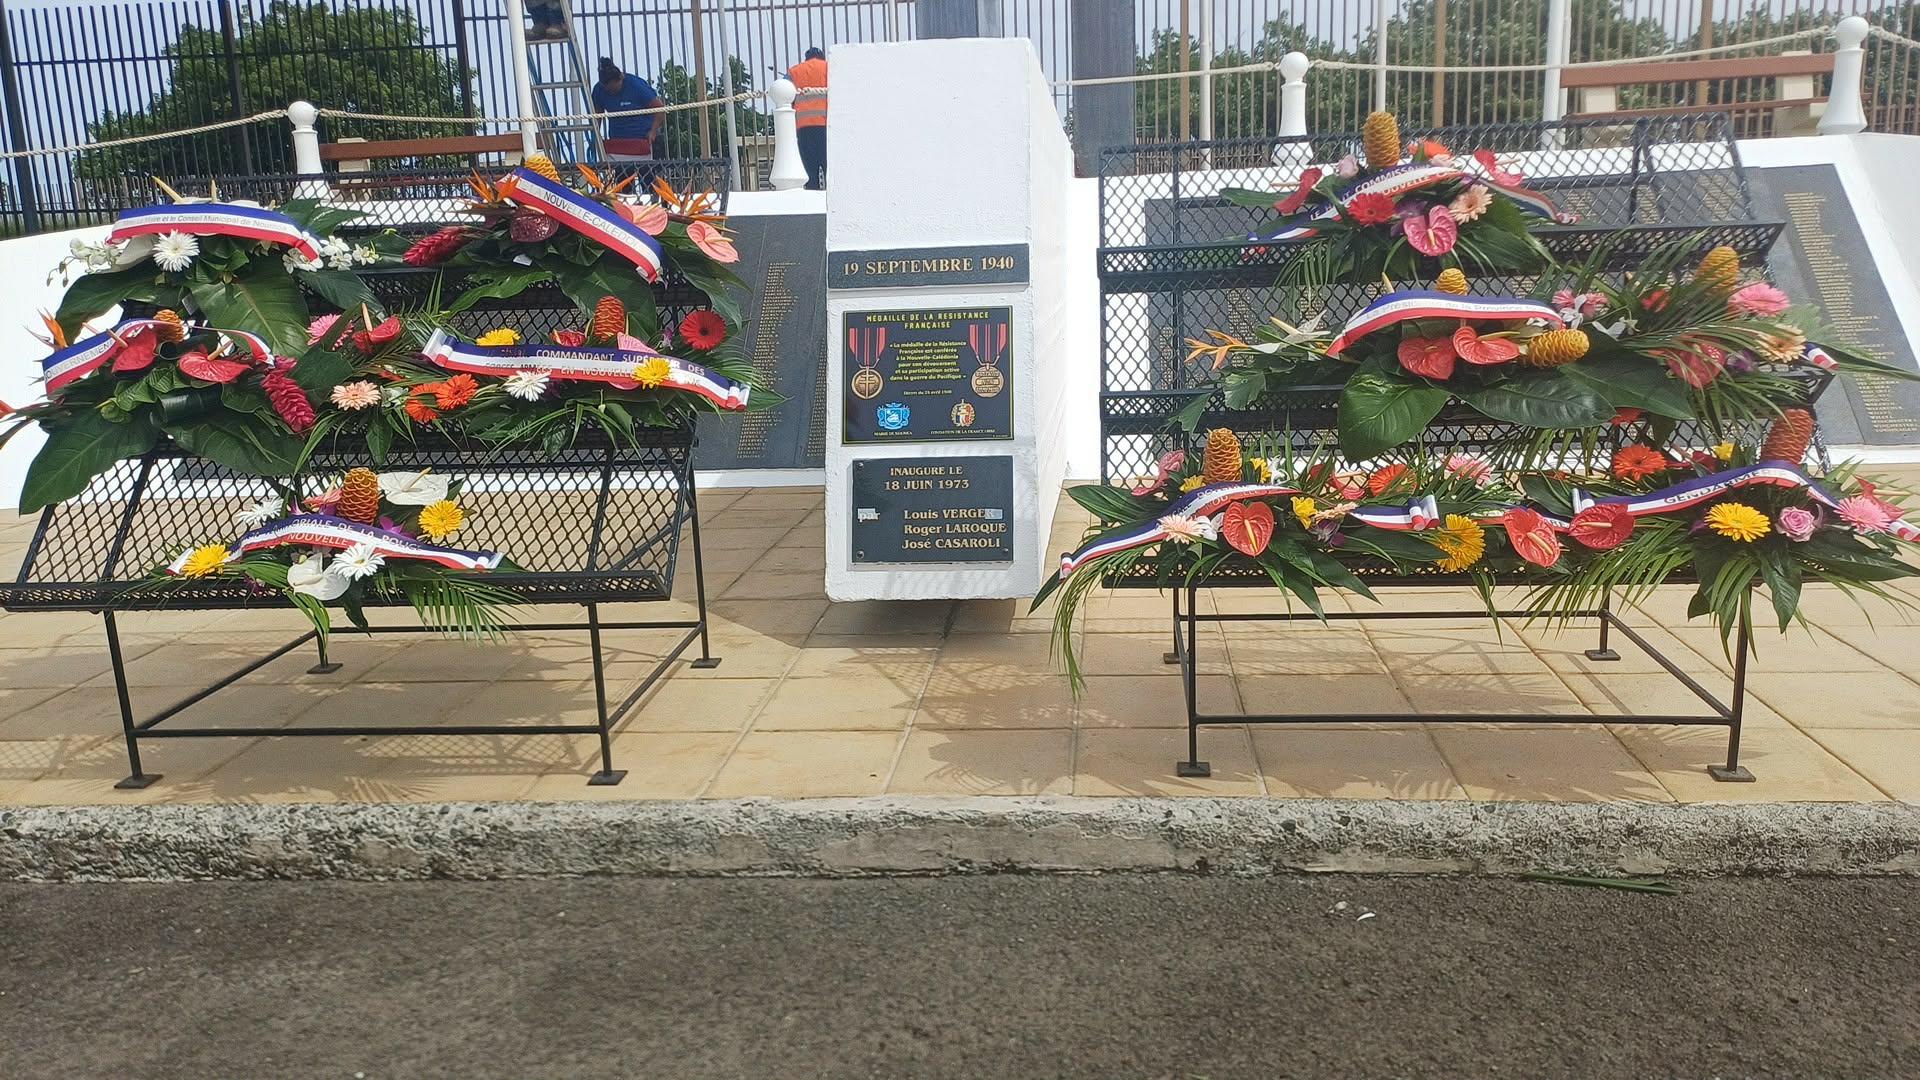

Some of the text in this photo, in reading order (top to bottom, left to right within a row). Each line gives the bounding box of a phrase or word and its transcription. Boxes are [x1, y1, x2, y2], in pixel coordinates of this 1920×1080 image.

[843, 255, 1015, 276] 19 SEPTEMBRE 1940
[909, 313, 920, 321] DE
[923, 312, 933, 321] LA
[536, 349, 615, 362] COMMANDANT
[687, 364, 705, 376] DES
[890, 466, 964, 477] INAUGURE LE
[884, 479, 970, 491] 18 JUIN 1973
[858, 511, 880, 523] par
[904, 509, 939, 520] Louis
[904, 522, 1007, 536] Roger LAROQUE
[287, 532, 349, 546] NOUVELLE
[902, 538, 1001, 550] José CASAROLI
